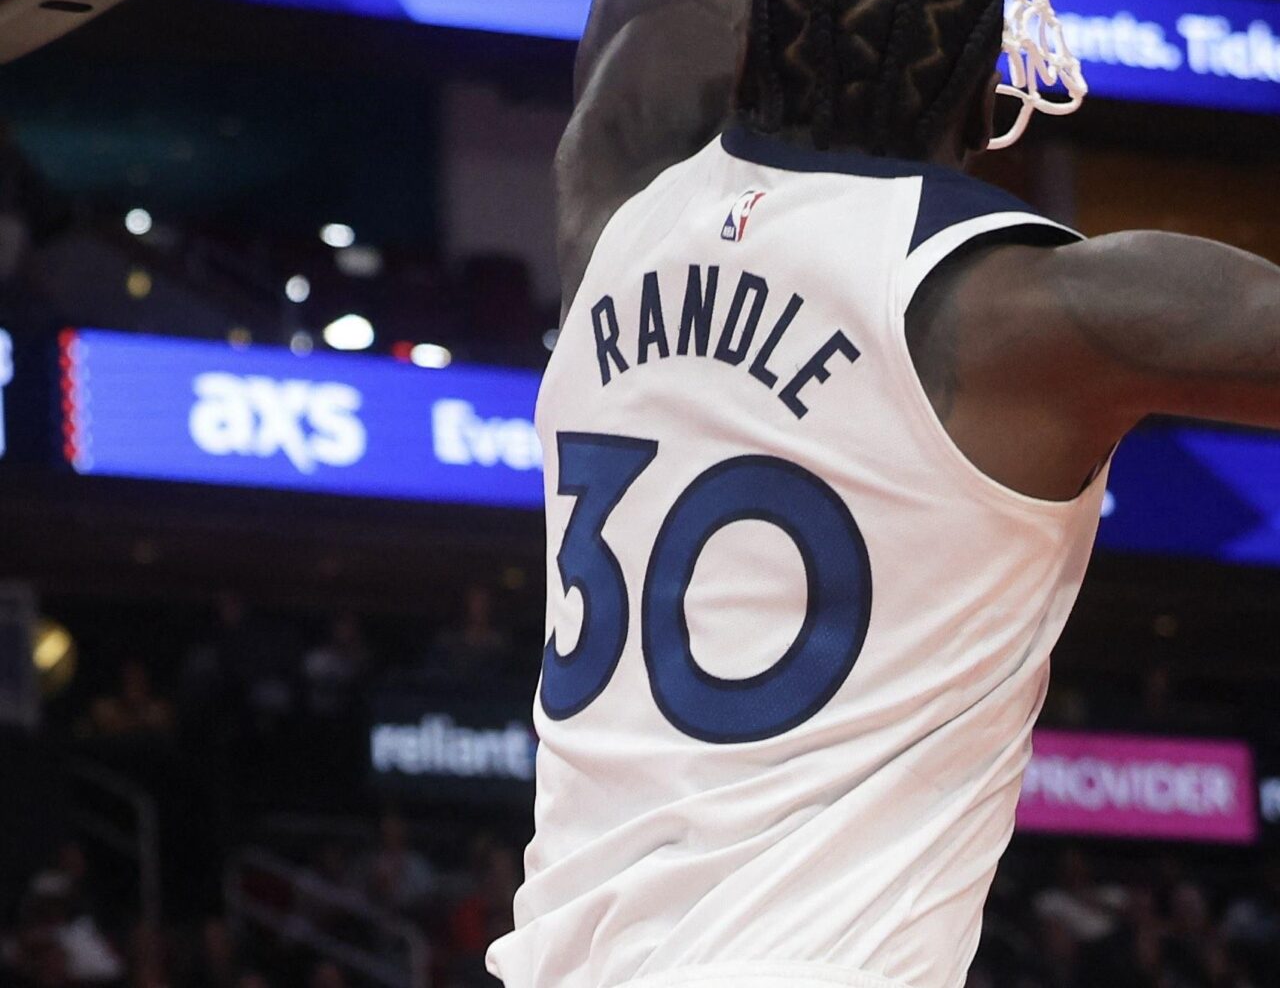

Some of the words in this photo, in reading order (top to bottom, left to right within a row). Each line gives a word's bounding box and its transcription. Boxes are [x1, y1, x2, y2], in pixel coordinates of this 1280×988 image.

[590, 264, 861, 419] RANDLE
[188, 372, 366, 474] axs
[431, 398, 543, 471] Eve
[540, 431, 873, 744] 30
[371, 715, 532, 781] reliant
